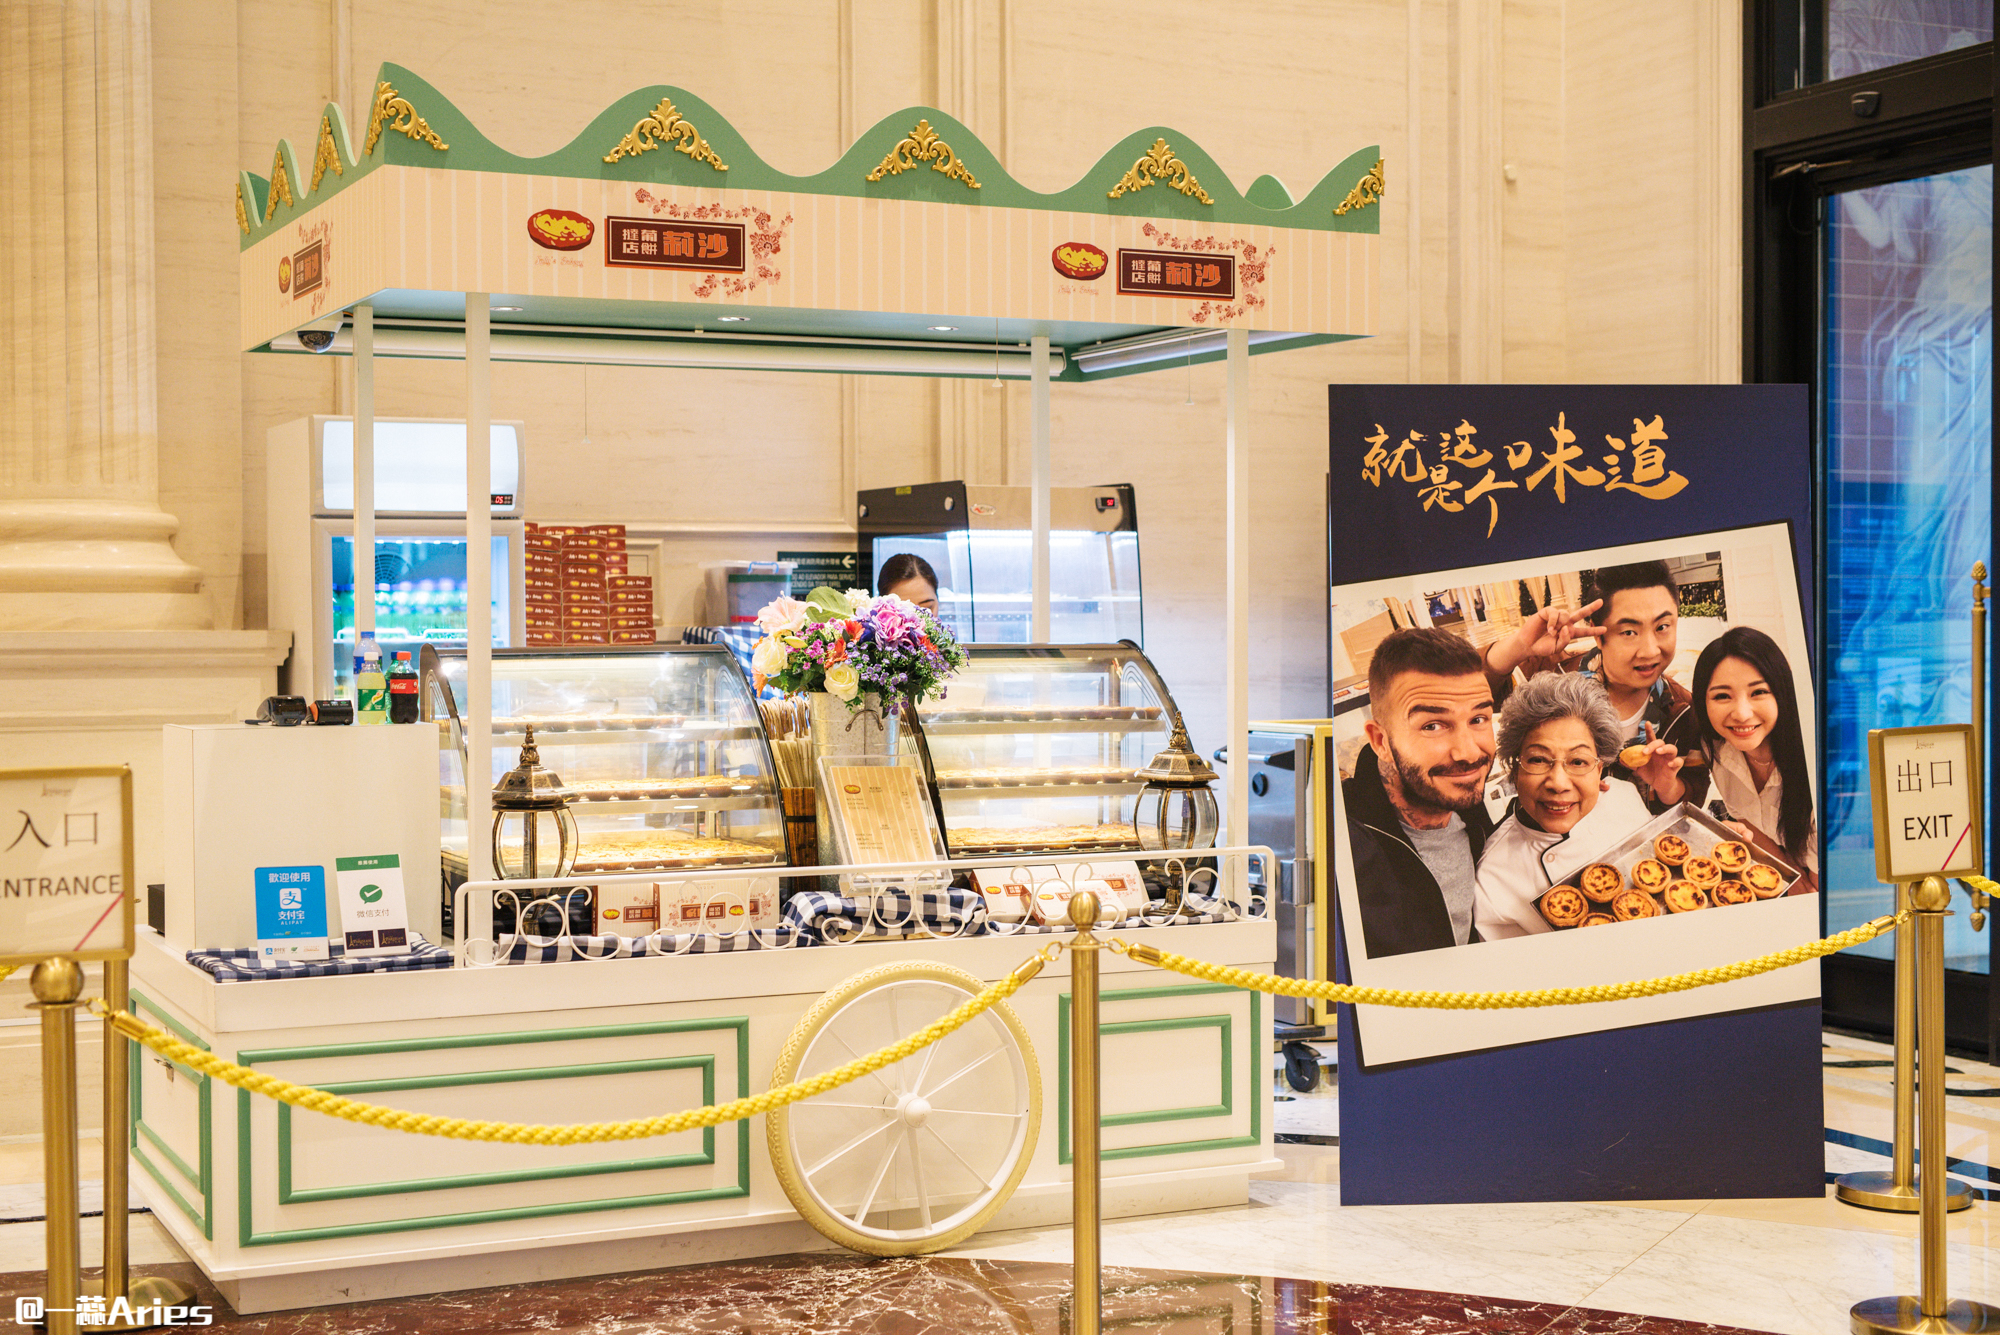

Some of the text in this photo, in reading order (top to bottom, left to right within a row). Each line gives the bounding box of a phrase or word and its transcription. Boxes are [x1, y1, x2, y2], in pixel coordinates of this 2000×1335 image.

[1897, 759, 1953, 793] 出口
[4, 809, 99, 852] 入口
[1903, 814, 1953, 841] EXIT
[0, 874, 122, 899] NTRANCE
[268, 872, 311, 883] 歡迎使用
[278, 910, 305, 920] 支付宝
[356, 908, 390, 918] 微信支付
